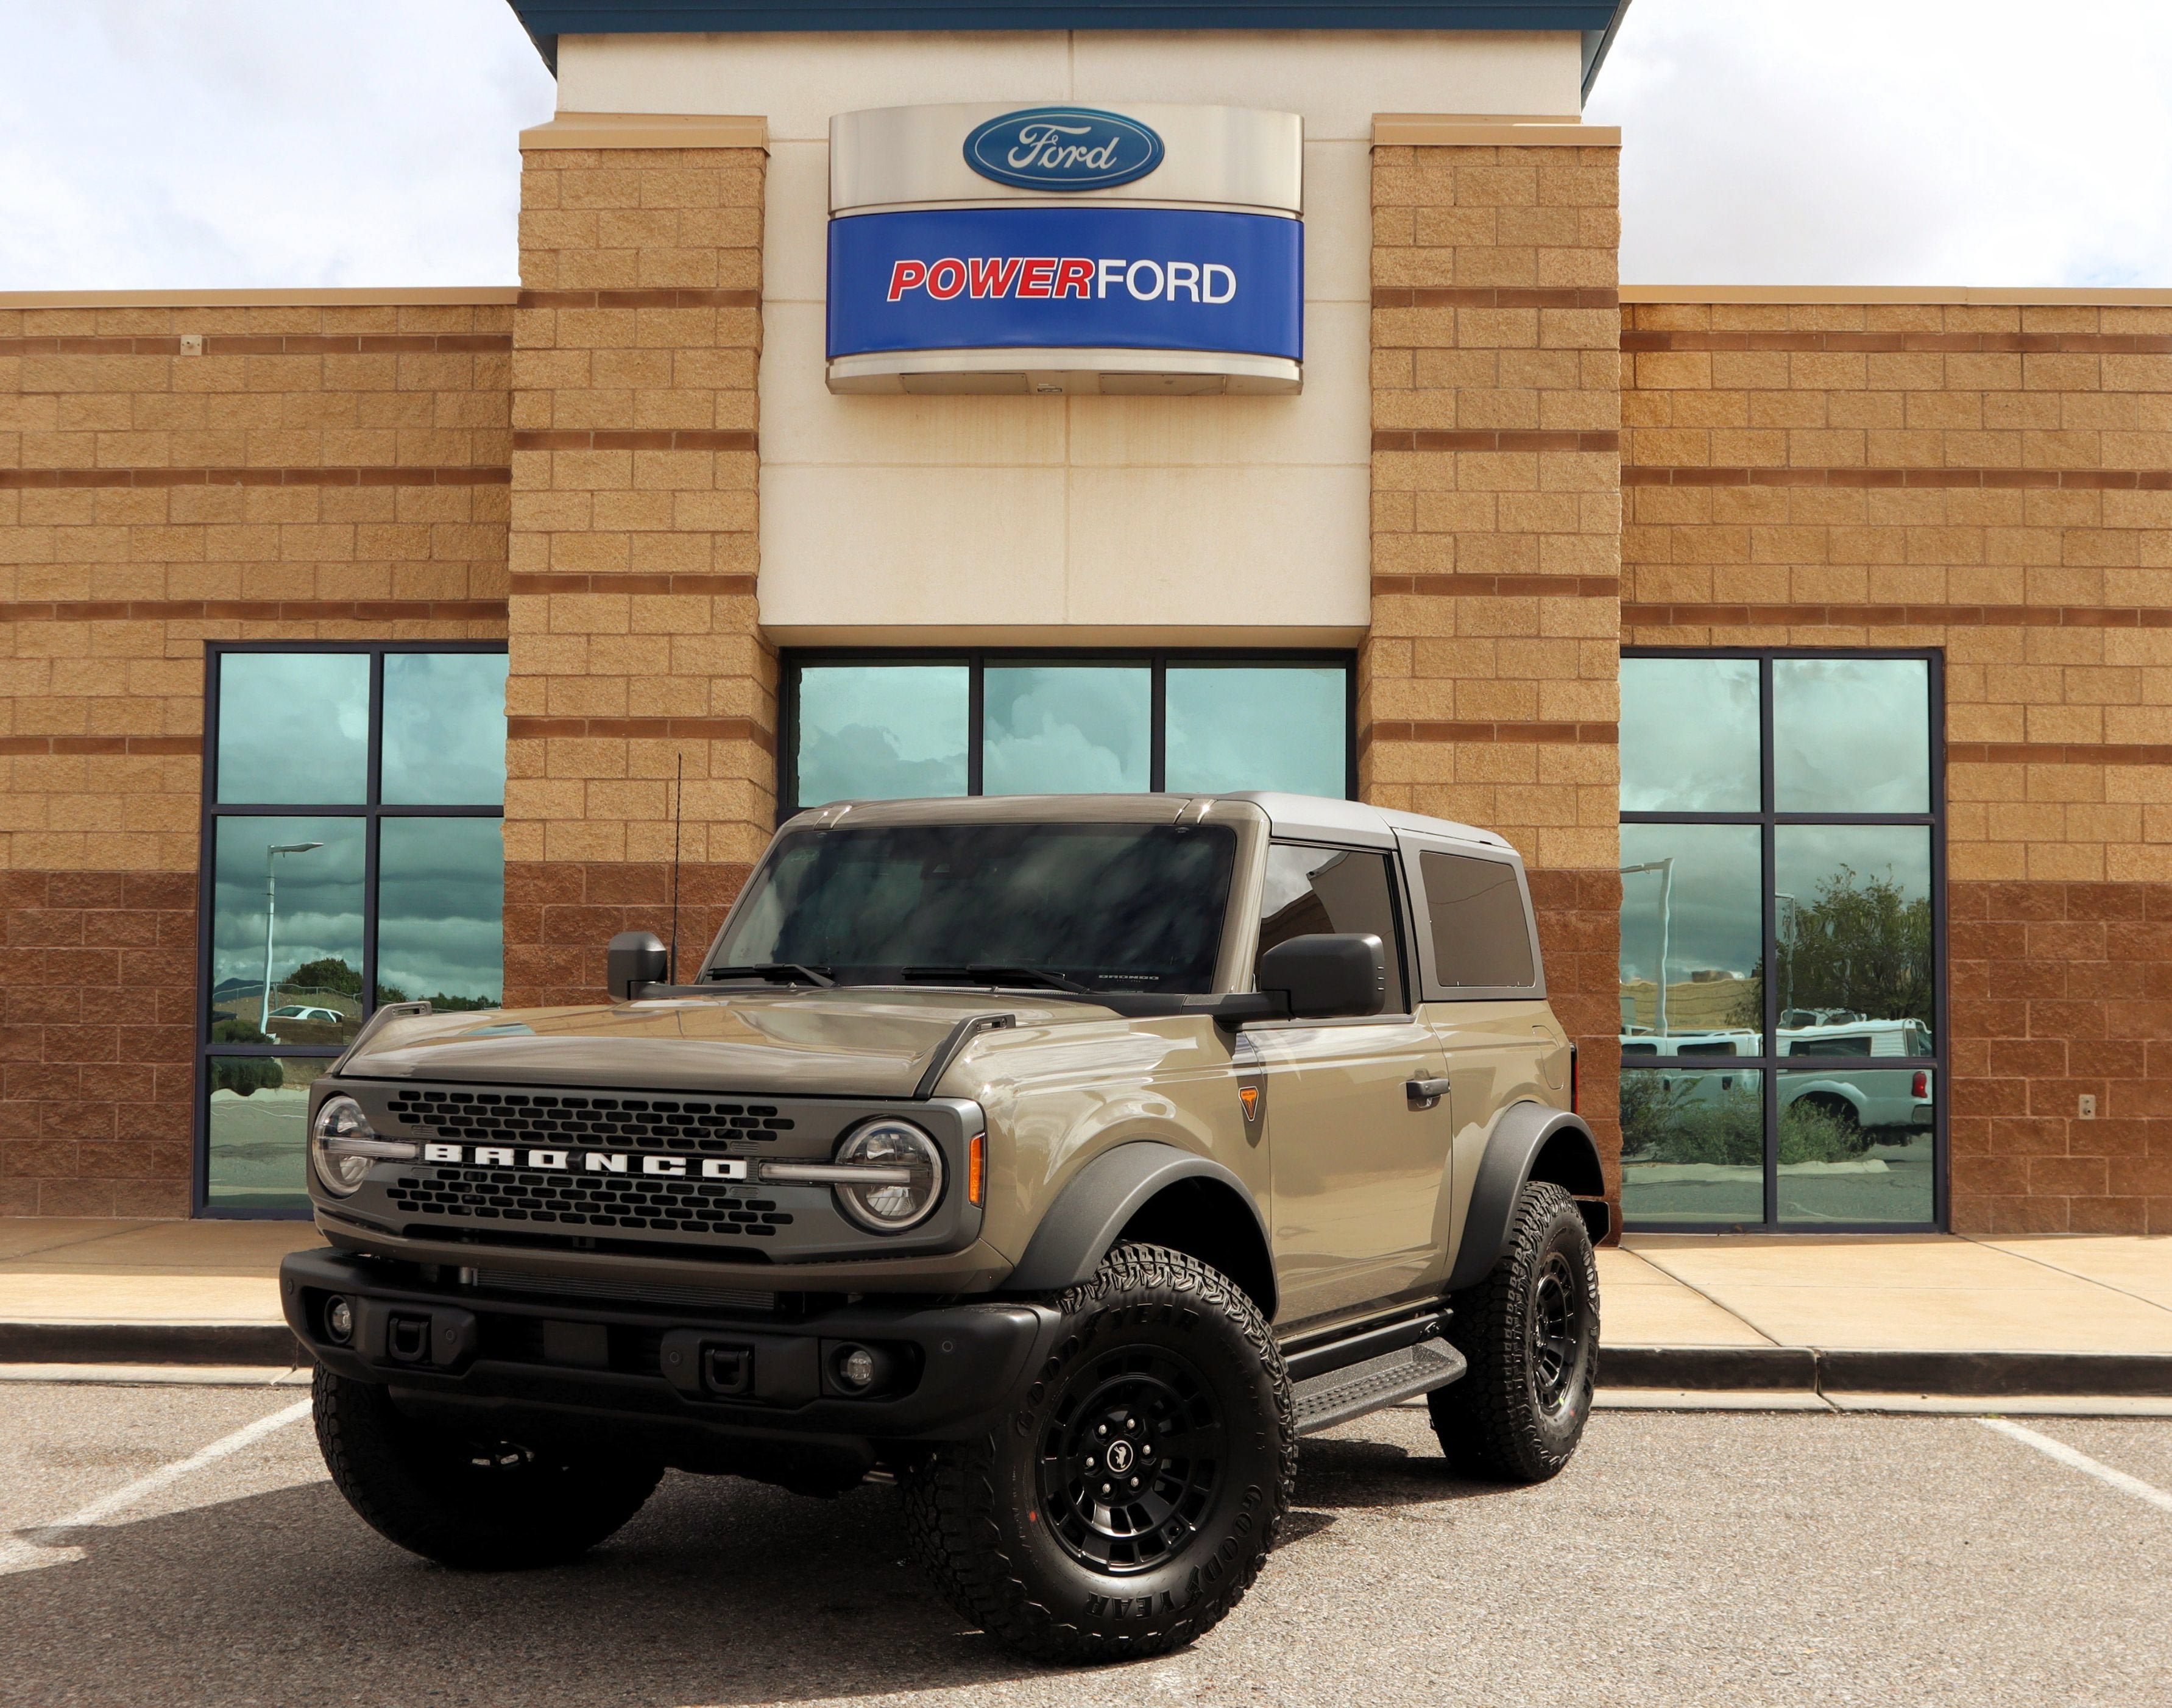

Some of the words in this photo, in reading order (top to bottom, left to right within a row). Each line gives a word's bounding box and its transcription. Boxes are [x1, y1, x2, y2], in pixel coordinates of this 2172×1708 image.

[1008, 124, 1120, 169] Ford
[425, 1143, 747, 1179] BRONCO
[1084, 1484, 1263, 1620] GOODYEAR
